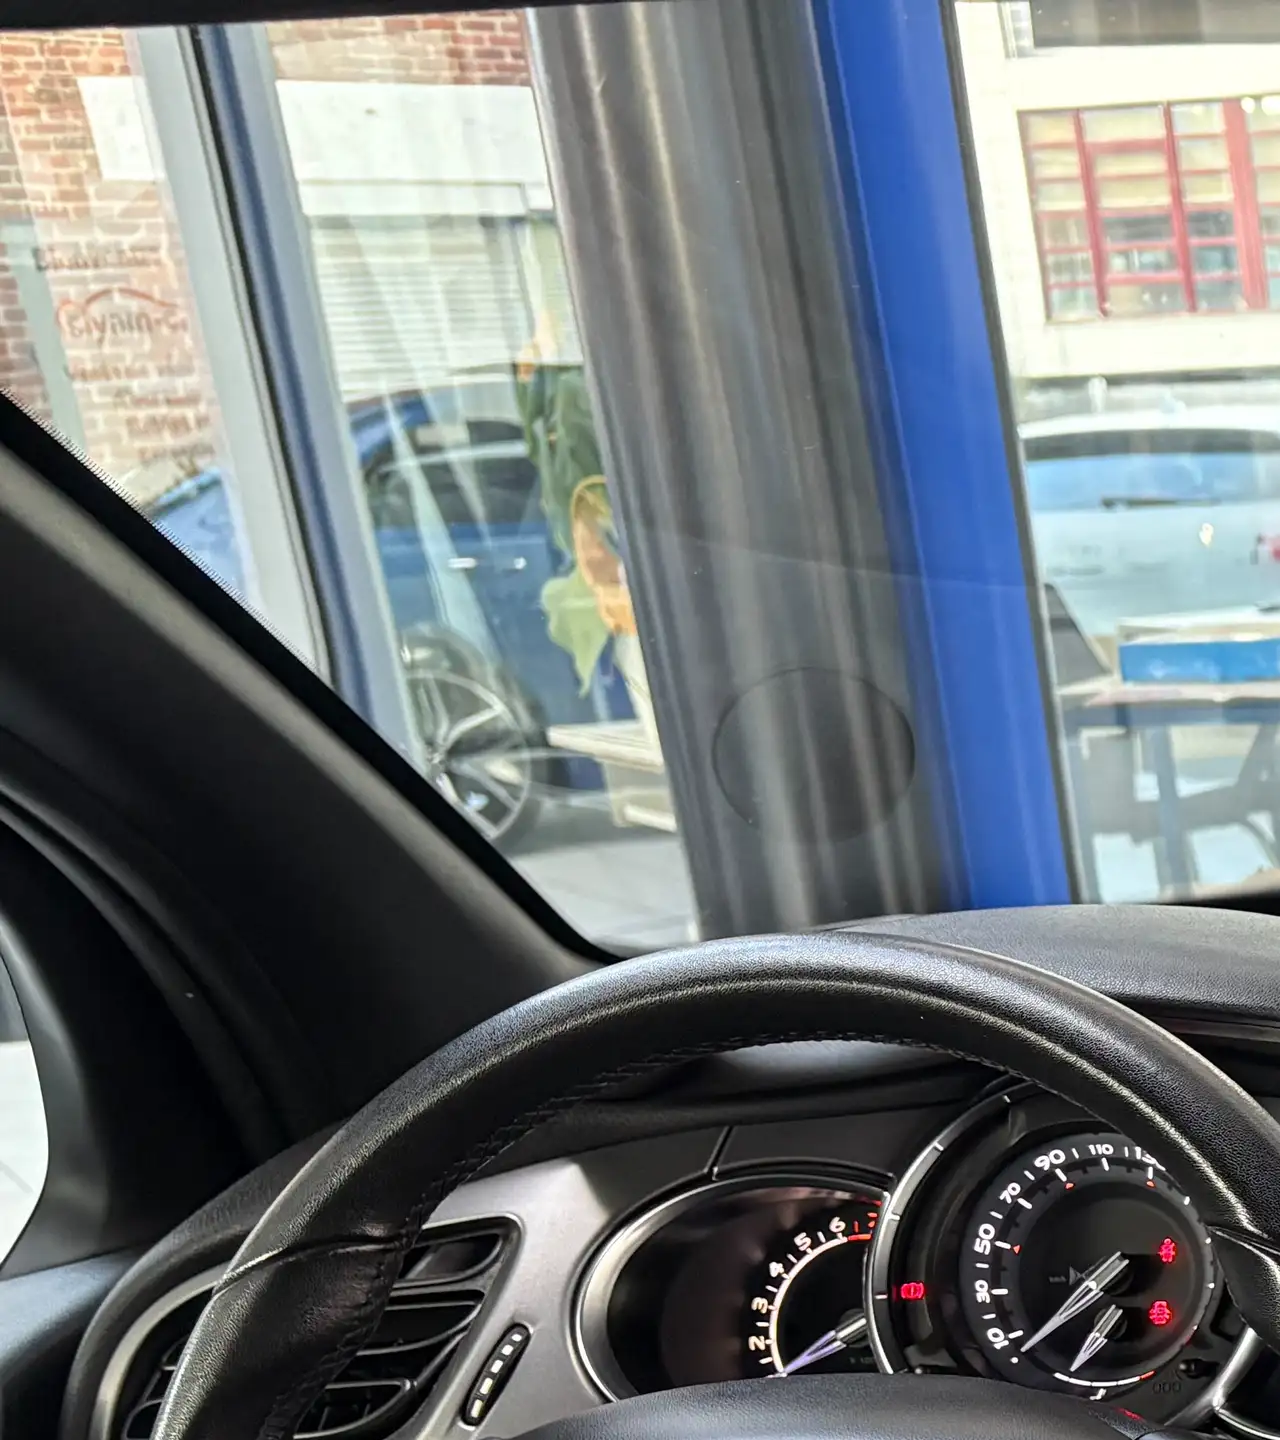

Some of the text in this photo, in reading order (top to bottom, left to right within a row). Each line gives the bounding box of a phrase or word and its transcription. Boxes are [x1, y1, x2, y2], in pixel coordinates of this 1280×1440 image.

[1088, 1144, 1114, 1155] 110
[1034, 1149, 1066, 1171] 90
[999, 1182, 1021, 1204] 70
[829, 1217, 846, 1233] 6
[793, 1232, 812, 1252] 5
[973, 1223, 995, 1255] 50
[768, 1261, 785, 1278] 4
[974, 1279, 990, 1303] 30
[751, 1297, 769, 1314] 3
[748, 1336, 766, 1351] 2
[986, 1328, 1010, 1350] 10
